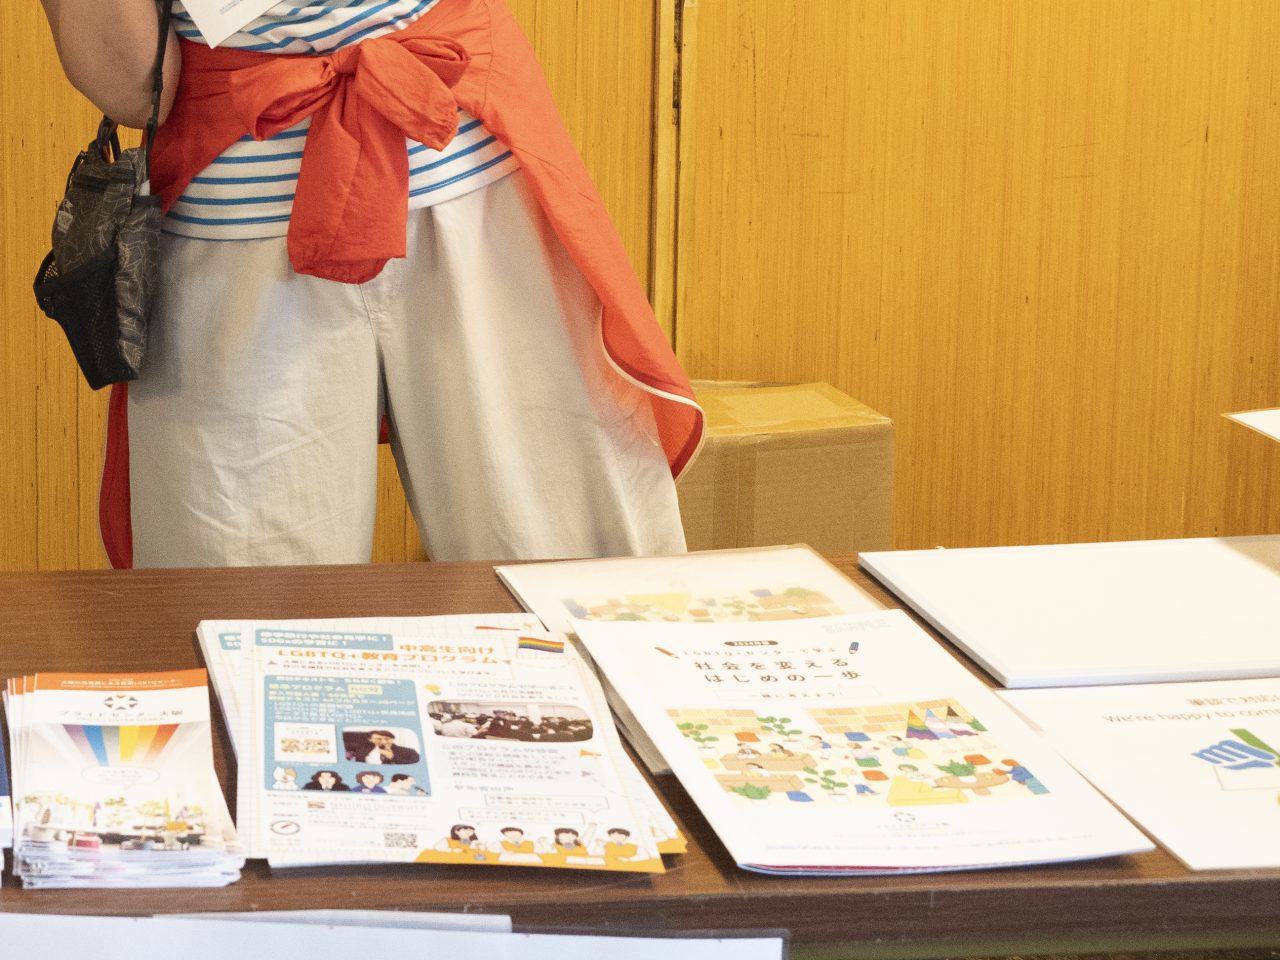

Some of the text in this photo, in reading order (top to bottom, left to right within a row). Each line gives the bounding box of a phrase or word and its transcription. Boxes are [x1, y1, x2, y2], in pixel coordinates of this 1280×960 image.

[693, 657, 849, 671] 社会を変える
[704, 670, 861, 683] はじめの一歩
[1158, 711, 1211, 721] happy
[1214, 710, 1236, 718] to
